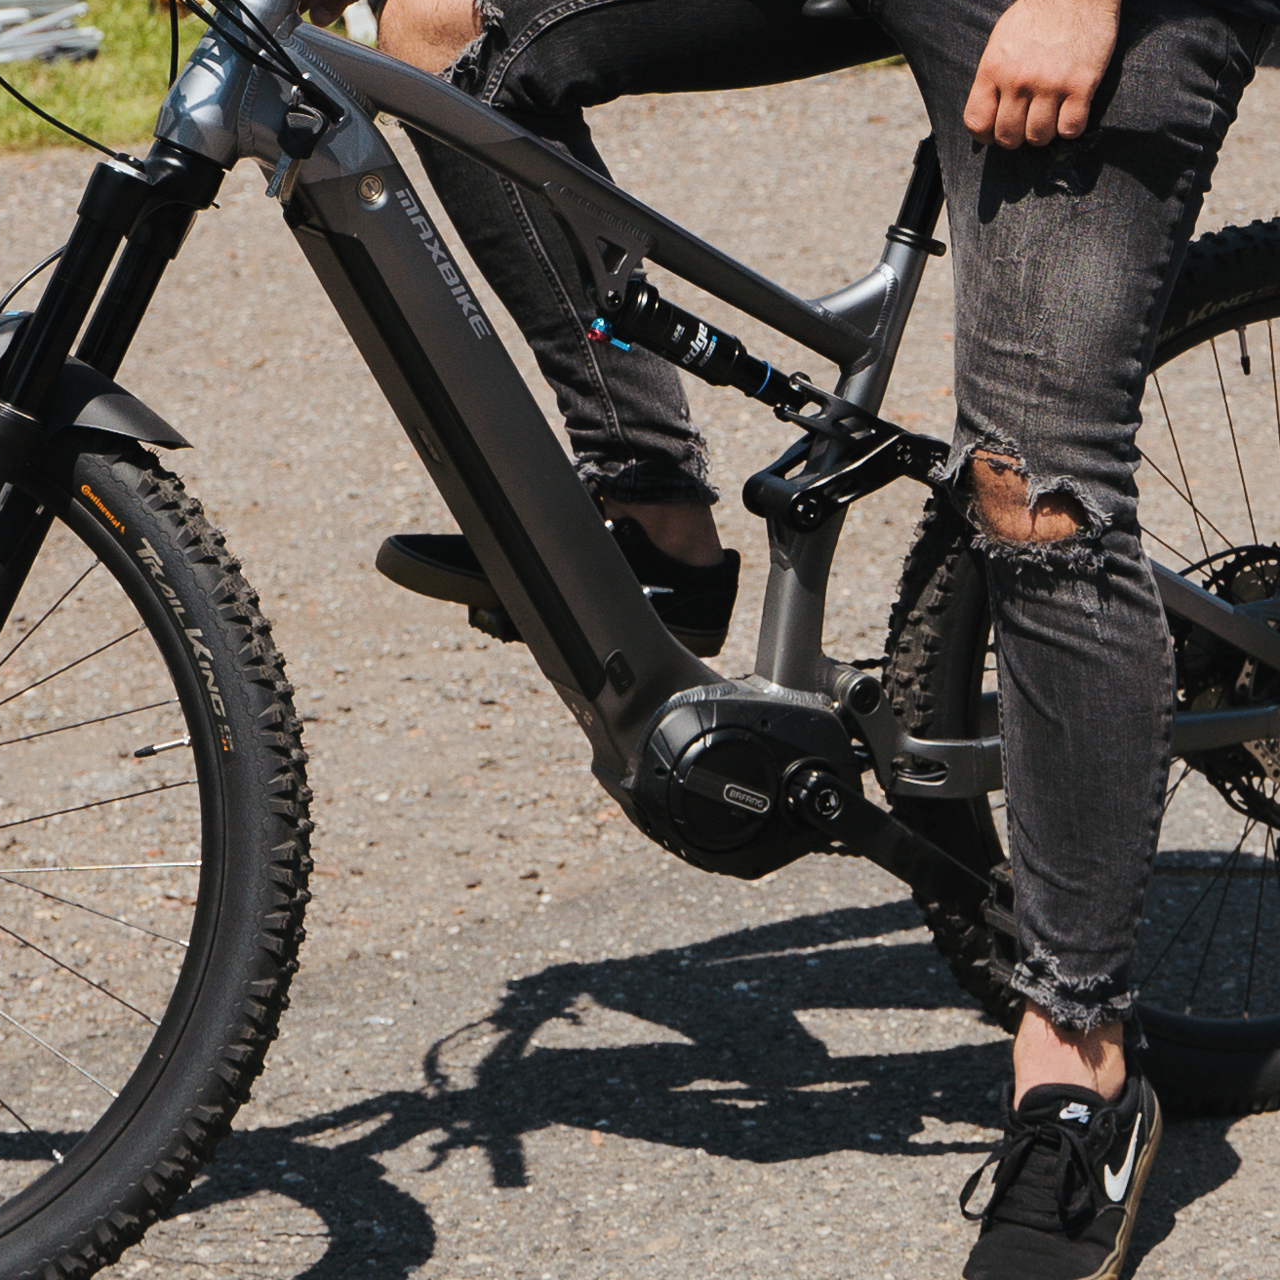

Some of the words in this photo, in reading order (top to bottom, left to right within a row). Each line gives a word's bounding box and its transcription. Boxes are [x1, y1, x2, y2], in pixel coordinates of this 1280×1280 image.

[682, 322, 709, 365] edge
[135, 537, 186, 628] TRAIL
[184, 628, 227, 718] KING
[729, 789, 764, 808] BAFANG
